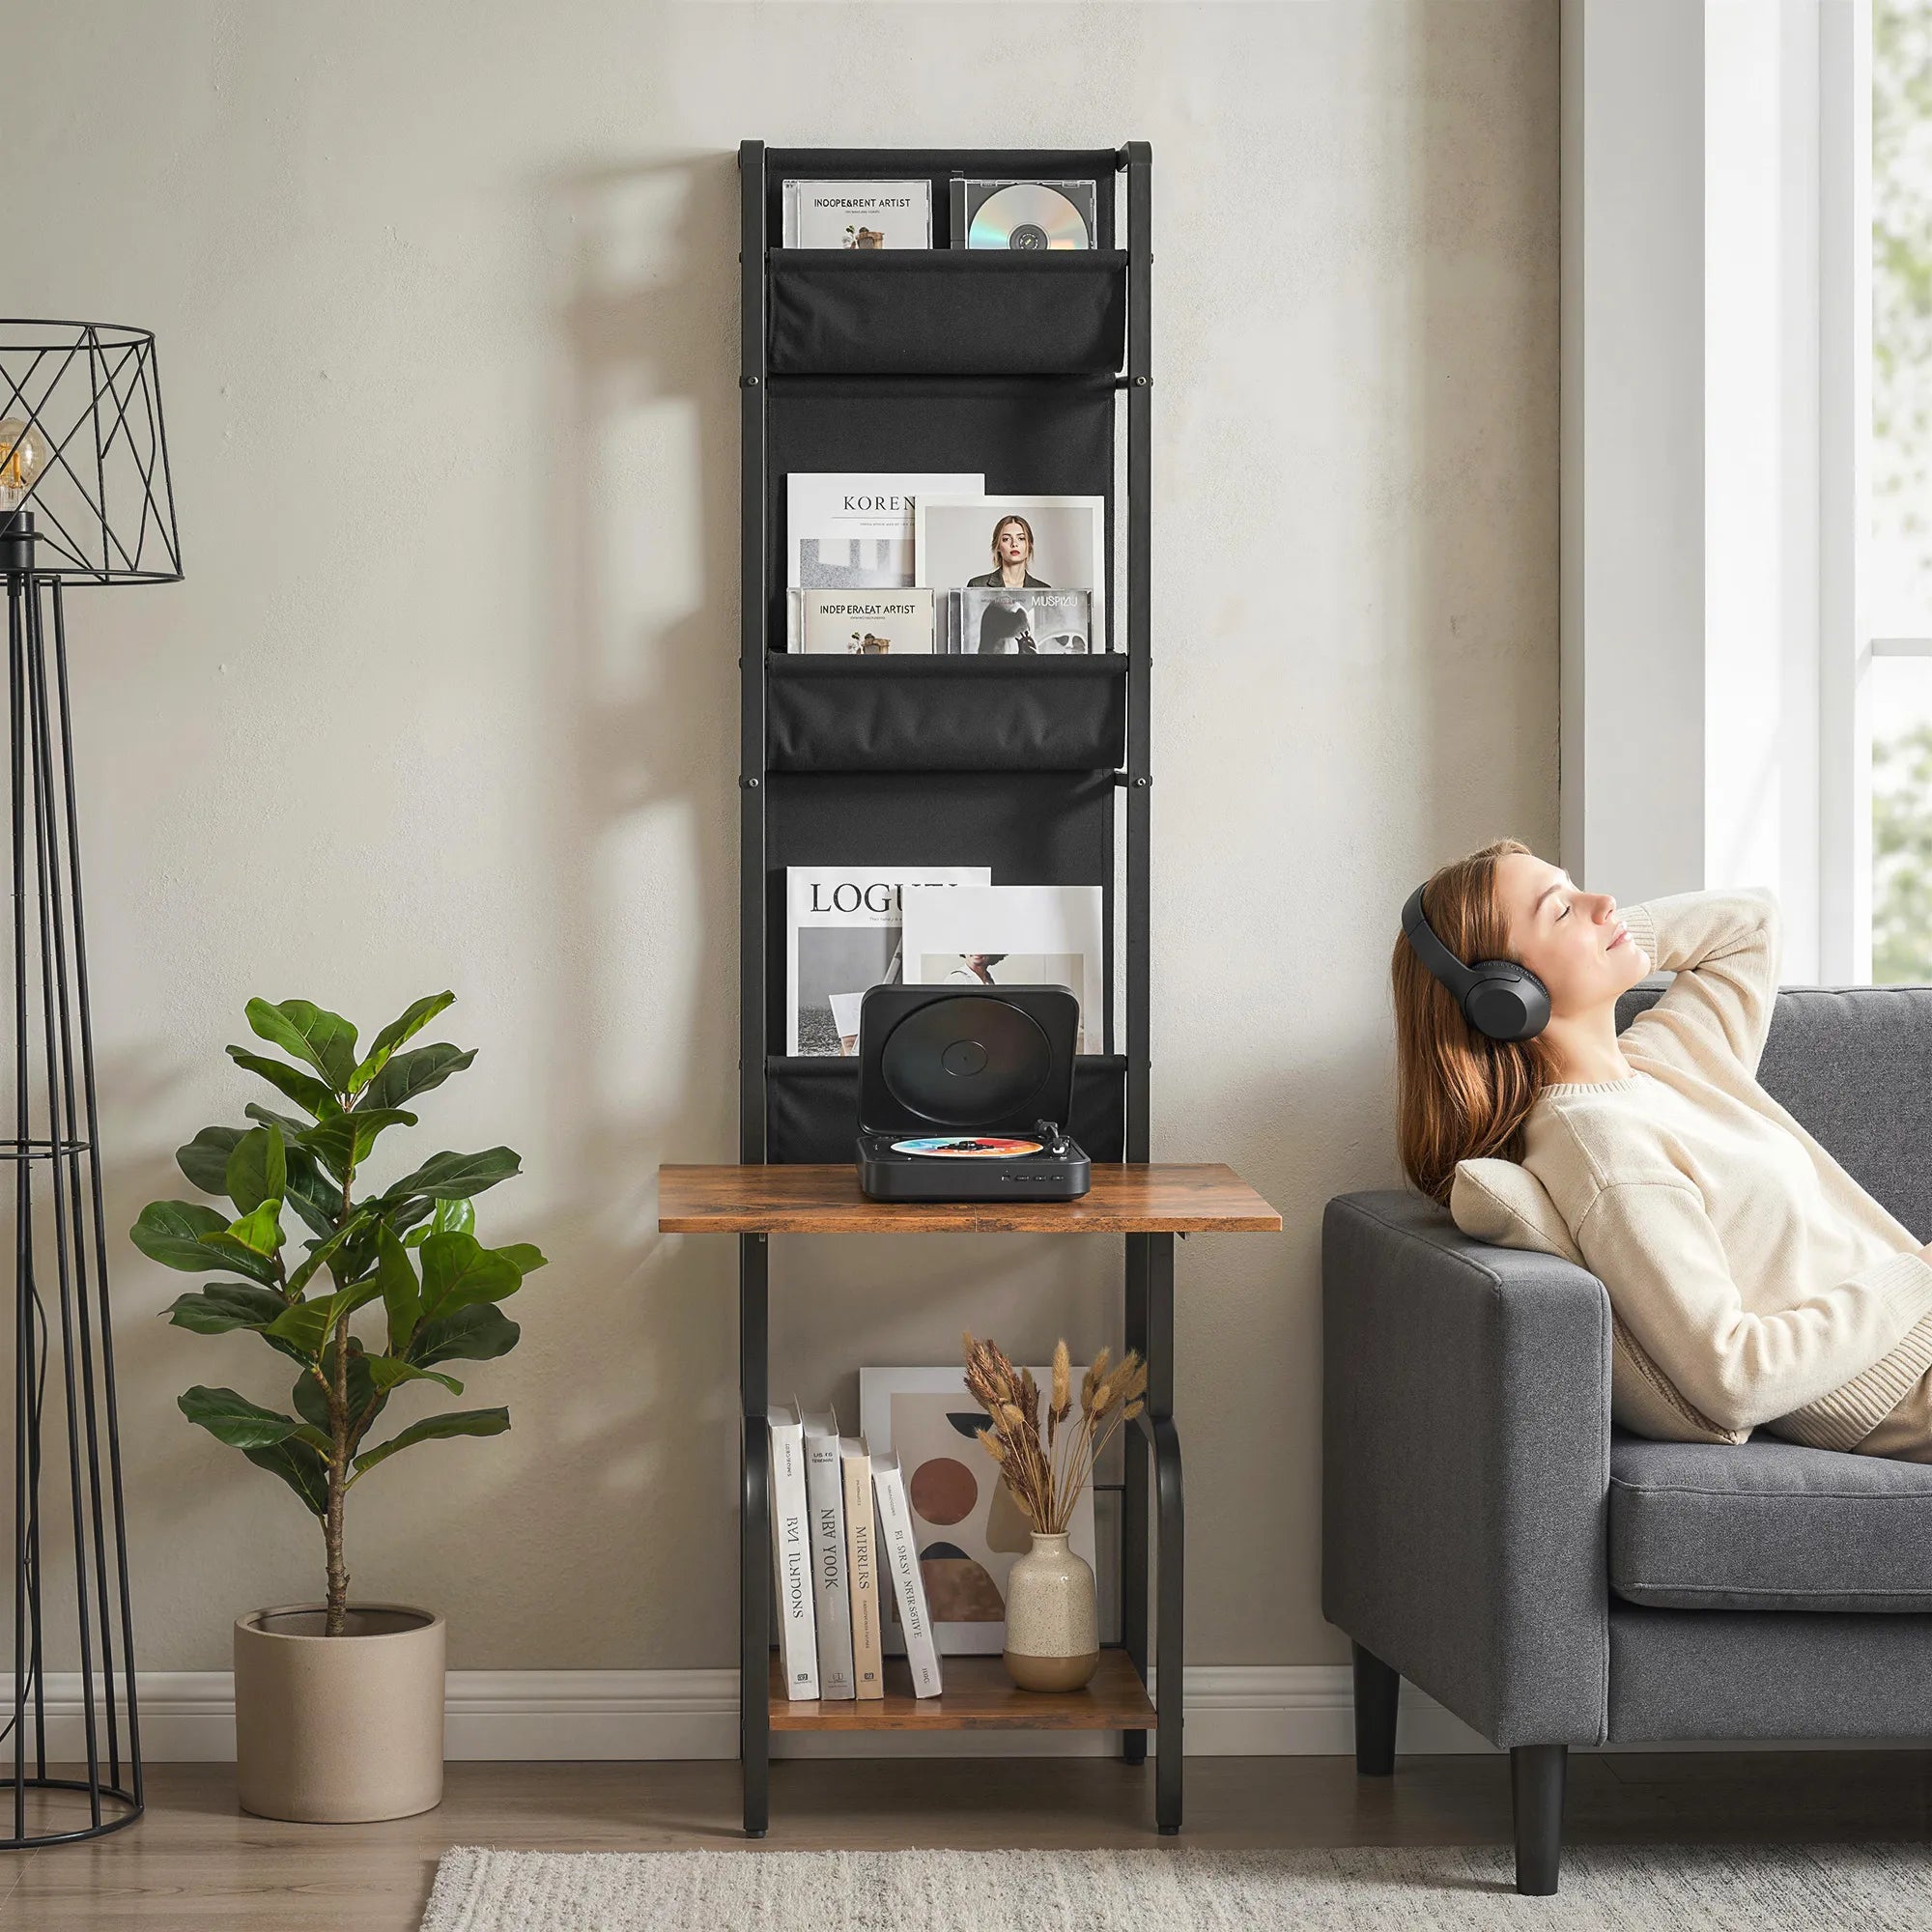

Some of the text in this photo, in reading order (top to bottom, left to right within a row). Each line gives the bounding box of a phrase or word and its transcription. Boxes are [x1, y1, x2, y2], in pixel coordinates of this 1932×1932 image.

[878, 198, 911, 208] ARTIST
[843, 496, 915, 511] KOREN
[883, 605, 916, 614] ARTIST
